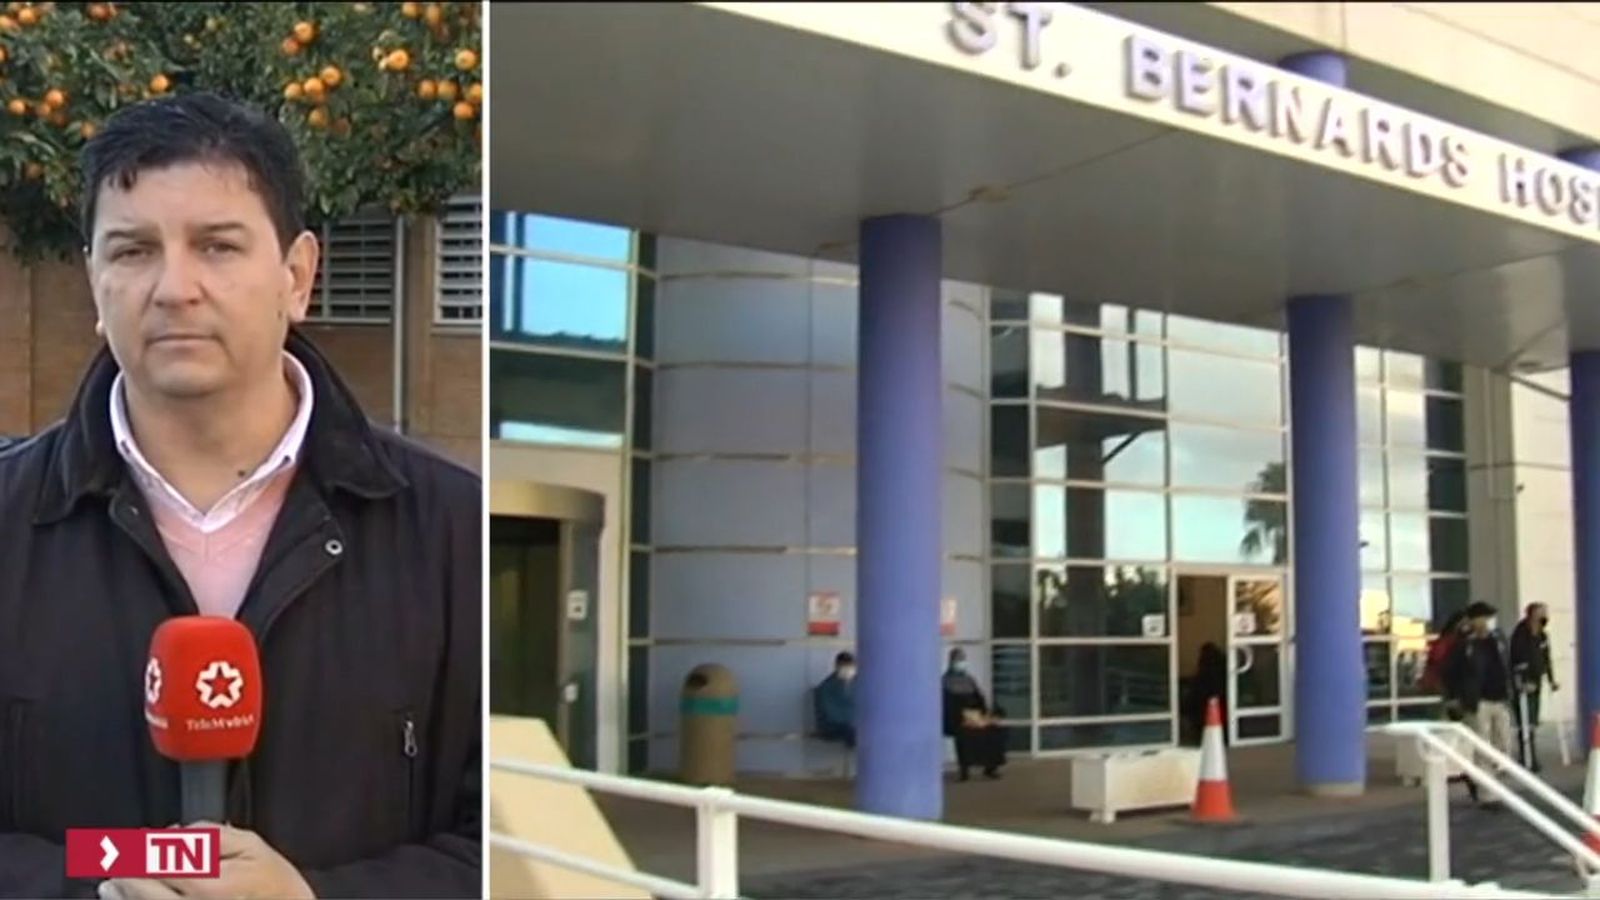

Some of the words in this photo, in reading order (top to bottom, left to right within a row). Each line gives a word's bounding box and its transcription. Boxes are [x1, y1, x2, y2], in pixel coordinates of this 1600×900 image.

[944, 2, 1071, 79] ST.
[1124, 34, 1470, 188] BERNARDS
[1498, 152, 1600, 232] HOS
